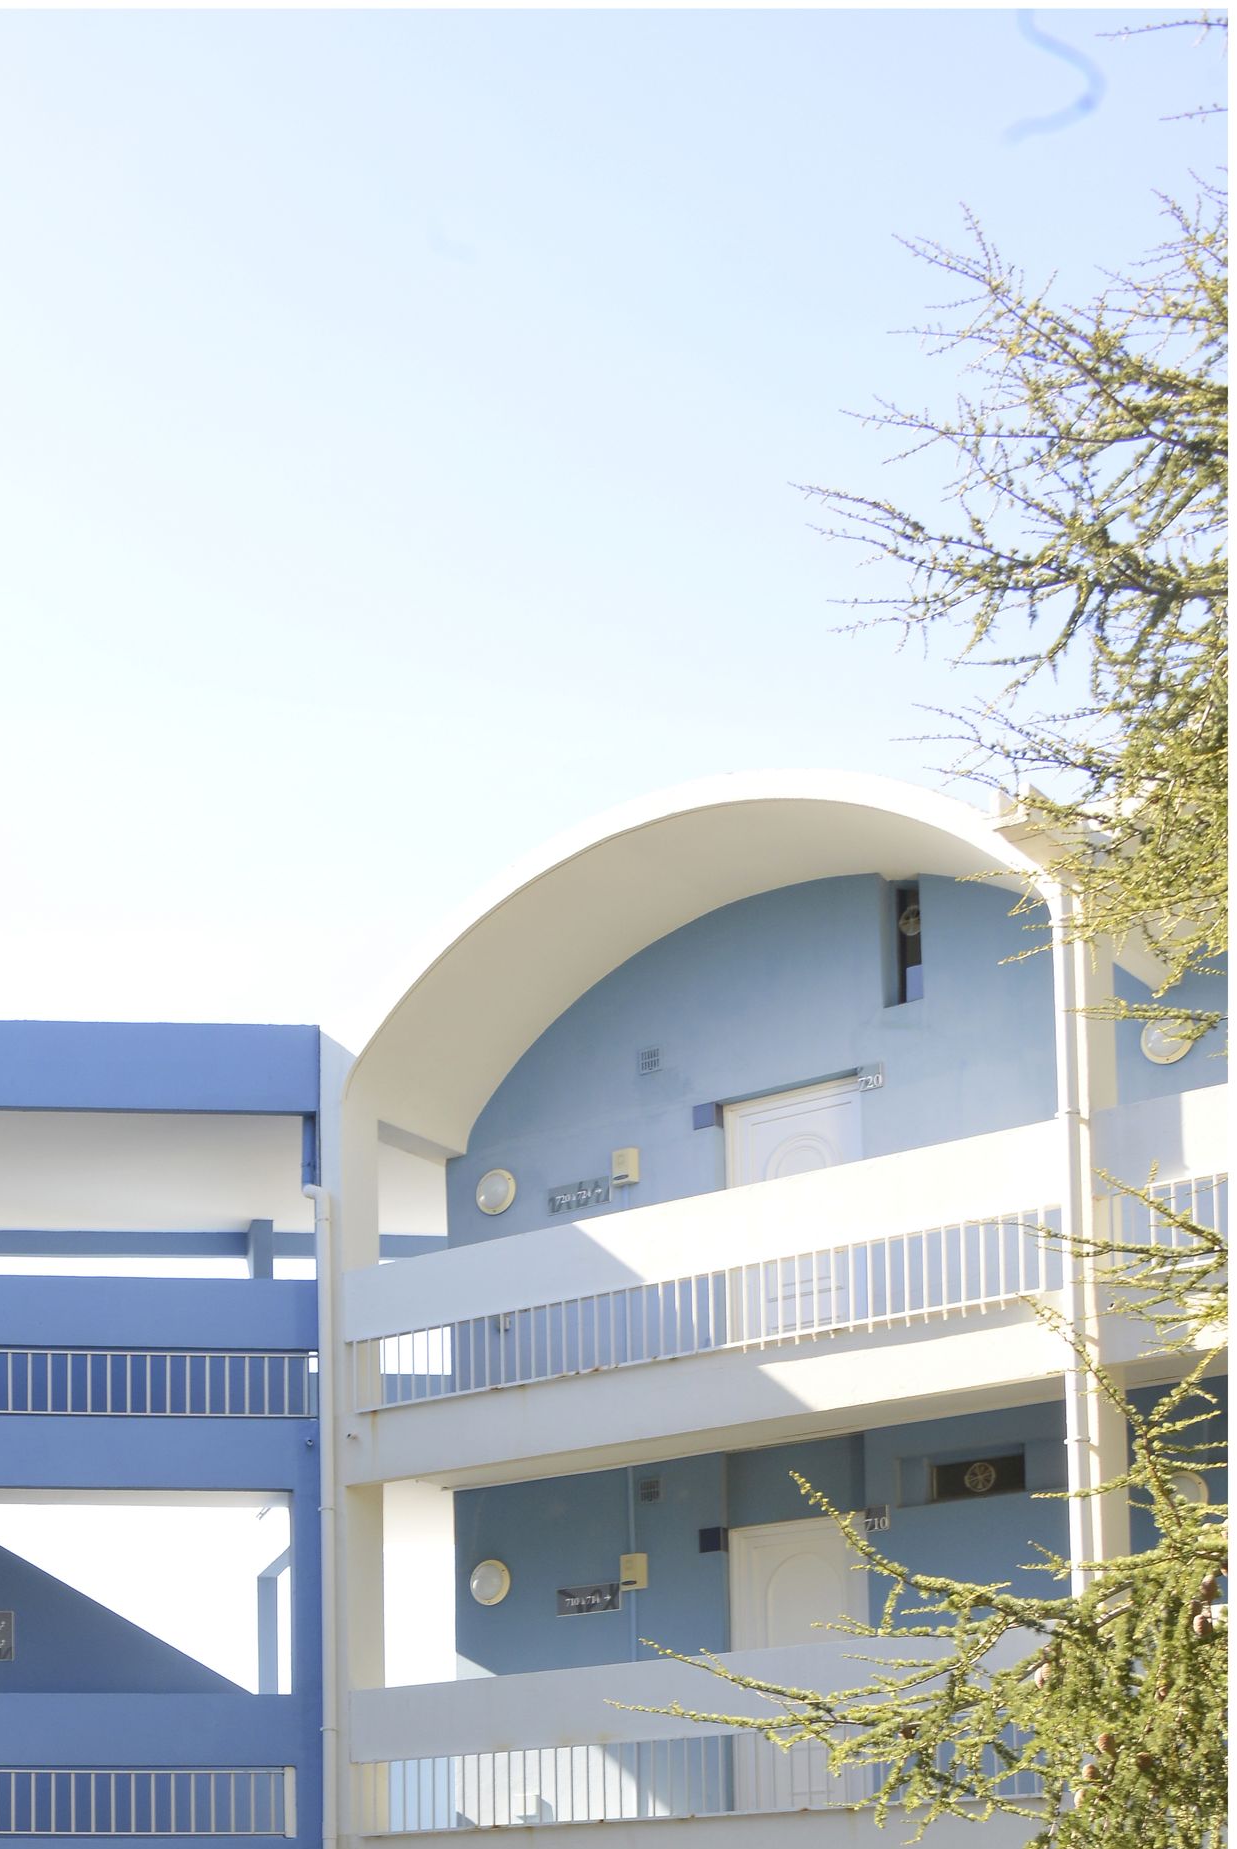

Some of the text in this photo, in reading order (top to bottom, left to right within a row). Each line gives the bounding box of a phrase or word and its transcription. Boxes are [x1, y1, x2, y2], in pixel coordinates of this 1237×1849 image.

[858, 1074, 882, 1090] 720
[556, 1193, 571, 1204] 720
[864, 1517, 889, 1531] 710
[565, 1598, 580, 1607] 710
